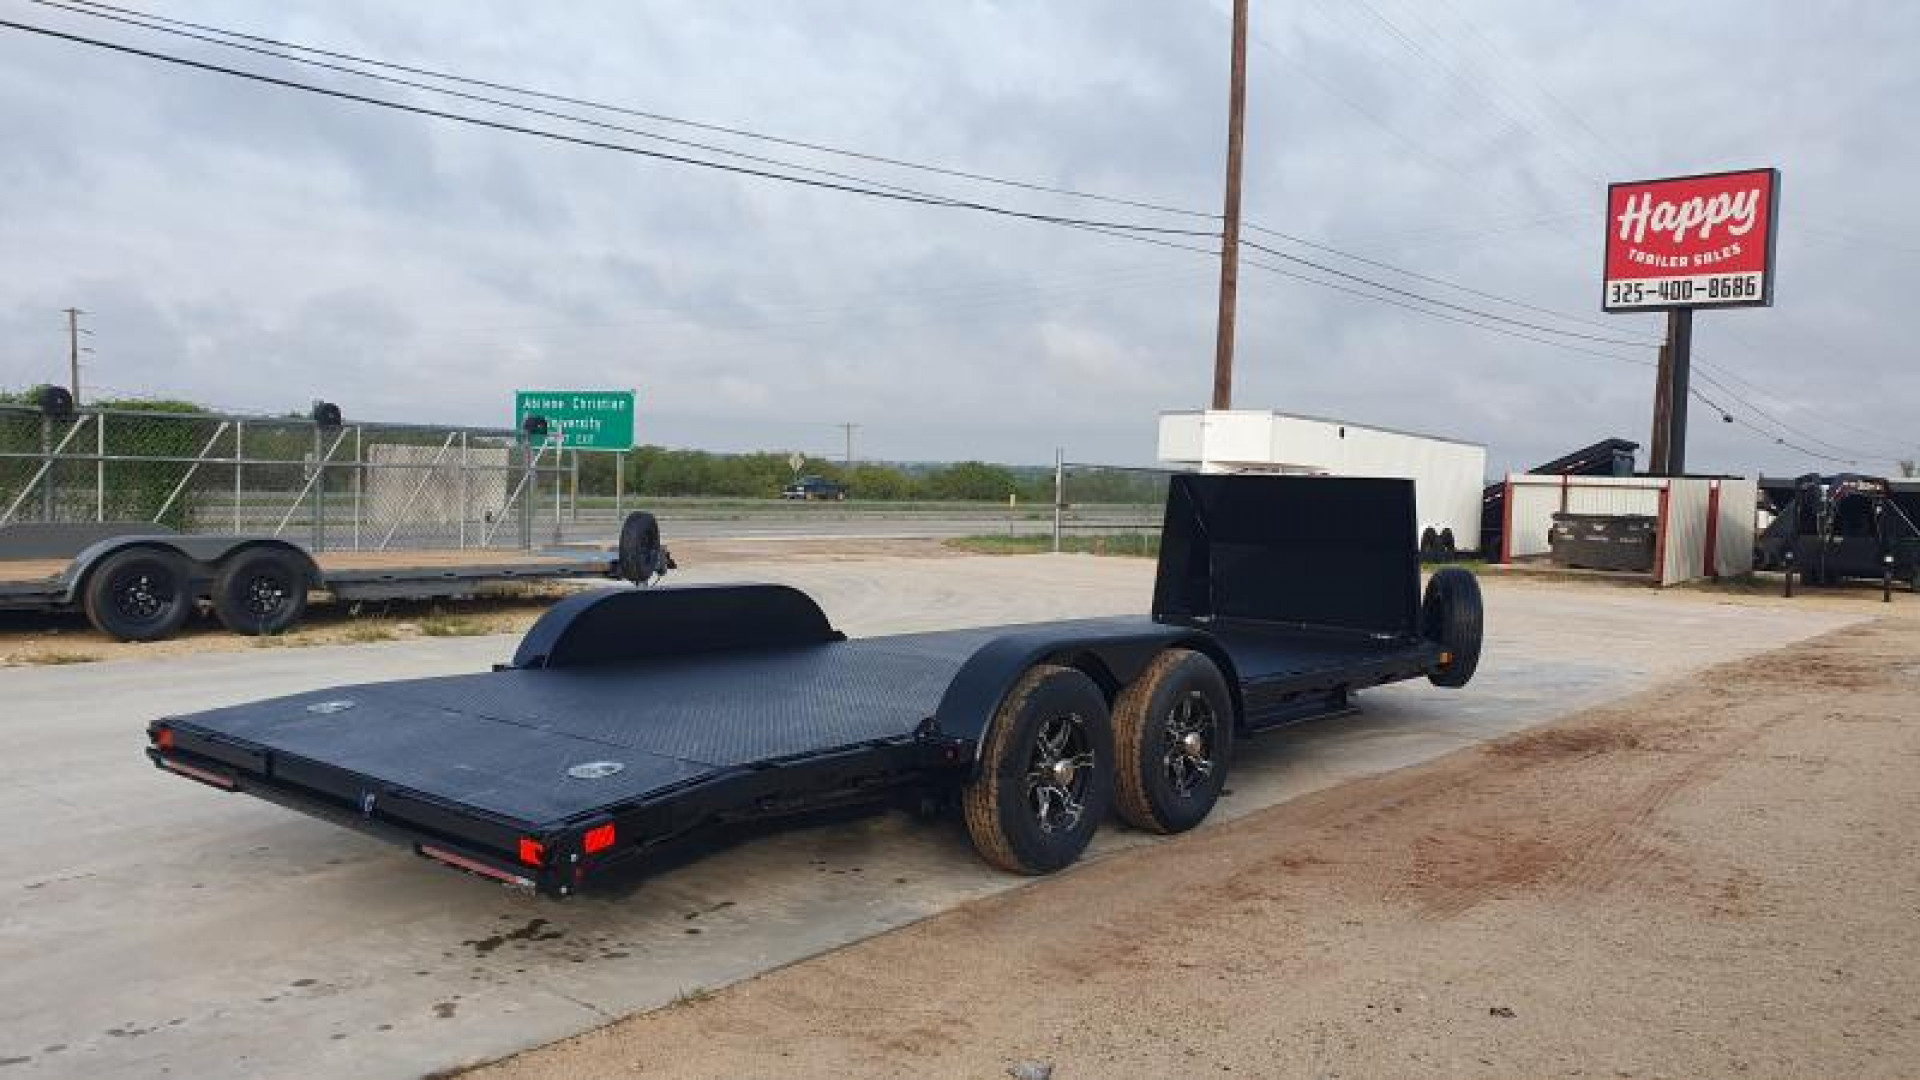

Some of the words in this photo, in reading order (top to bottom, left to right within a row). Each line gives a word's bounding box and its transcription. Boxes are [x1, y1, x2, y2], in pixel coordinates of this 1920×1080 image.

[1618, 189, 1760, 243] Happy
[1629, 249, 1688, 267] TRAILER
[1694, 242, 1741, 265] SALES
[1612, 275, 1756, 303] 325-400-8686
